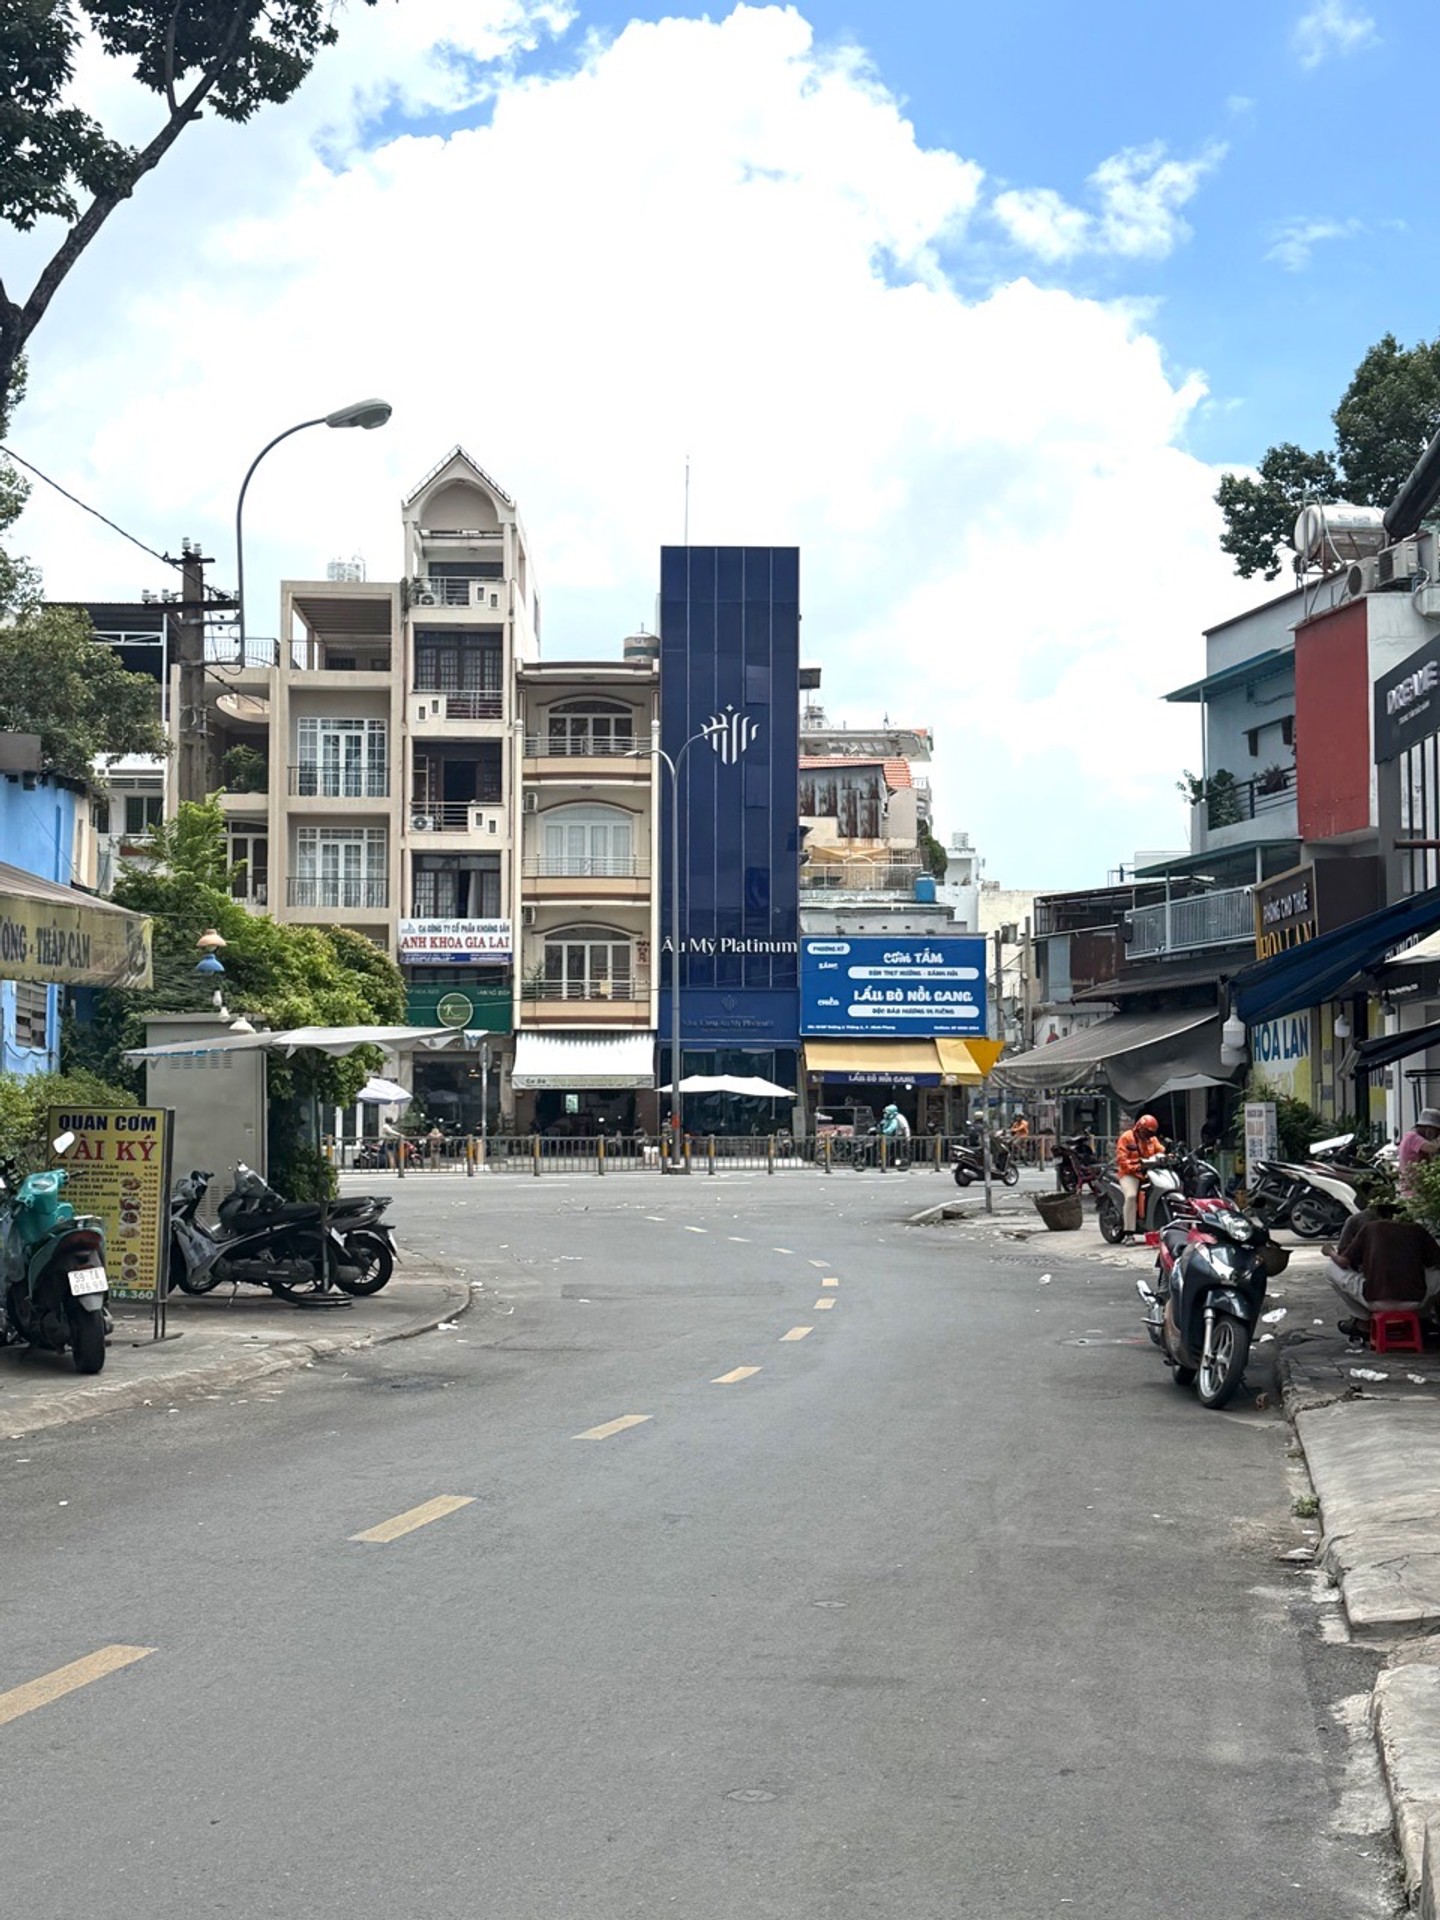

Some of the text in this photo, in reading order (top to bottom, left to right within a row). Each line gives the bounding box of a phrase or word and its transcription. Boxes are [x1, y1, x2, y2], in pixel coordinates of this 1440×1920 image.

[401, 936, 509, 949] ANH KHOA GIA LAI
[661, 936, 798, 956] Âu Mỹ Platinum
[914, 947, 944, 964] TẤM
[886, 988, 904, 1002] BÒ
[933, 990, 973, 1002] GANG
[1254, 1015, 1309, 1062] HOA LAN
[58, 1113, 157, 1131] QUÁN CƠM
[57, 1134, 157, 1160] ÀI KÝ
